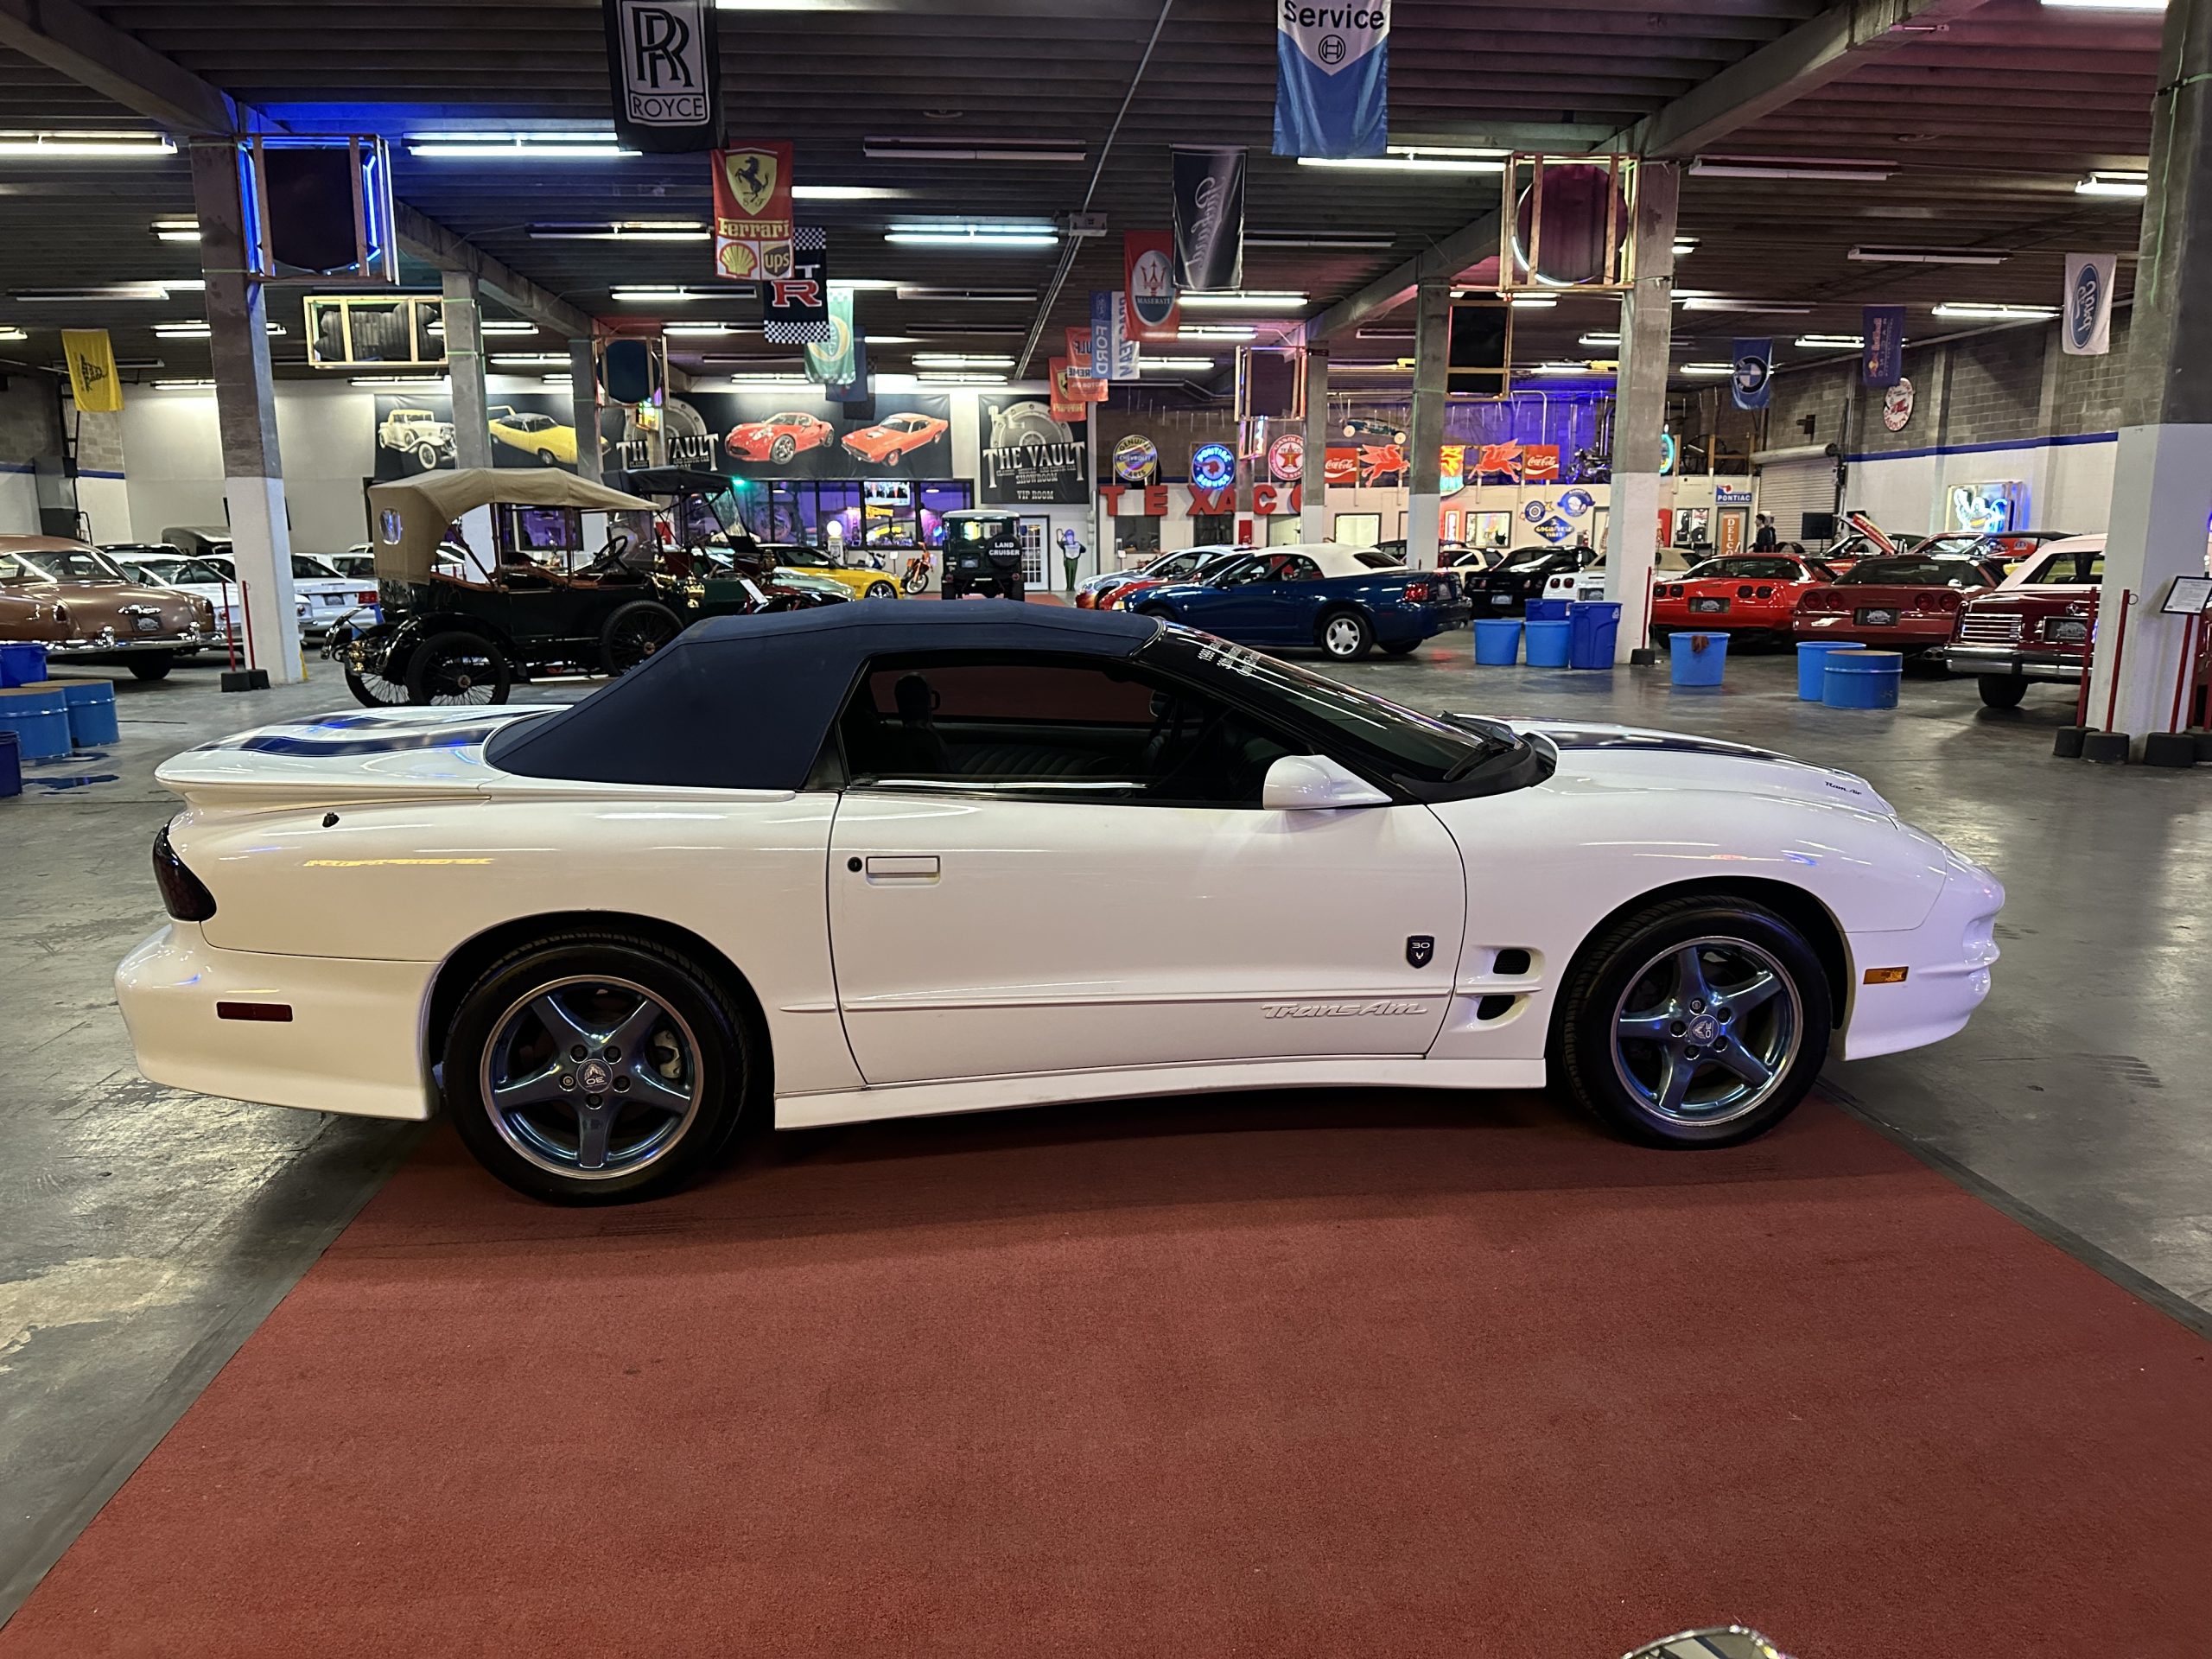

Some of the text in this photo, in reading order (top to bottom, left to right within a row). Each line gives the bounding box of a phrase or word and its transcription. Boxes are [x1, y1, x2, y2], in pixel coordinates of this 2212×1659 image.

[1283, 0, 1384, 29] Service
[632, 97, 703, 118] ROYCE
[717, 217, 791, 238] Ferrari
[765, 253, 790, 273] ups
[770, 279, 823, 308] R
[1196, 447, 1232, 462] PONTIAC
[982, 442, 1085, 488] THE VAULT
[1015, 473, 1058, 485] SHOWROOM
[1196, 474, 1230, 487] SERVICE
[1016, 490, 1054, 500] VIP ROOM
[1726, 518, 1736, 556] DELCO
[1824, 780, 1847, 791] Ram
[1261, 1001, 1427, 1019] Trans Am
